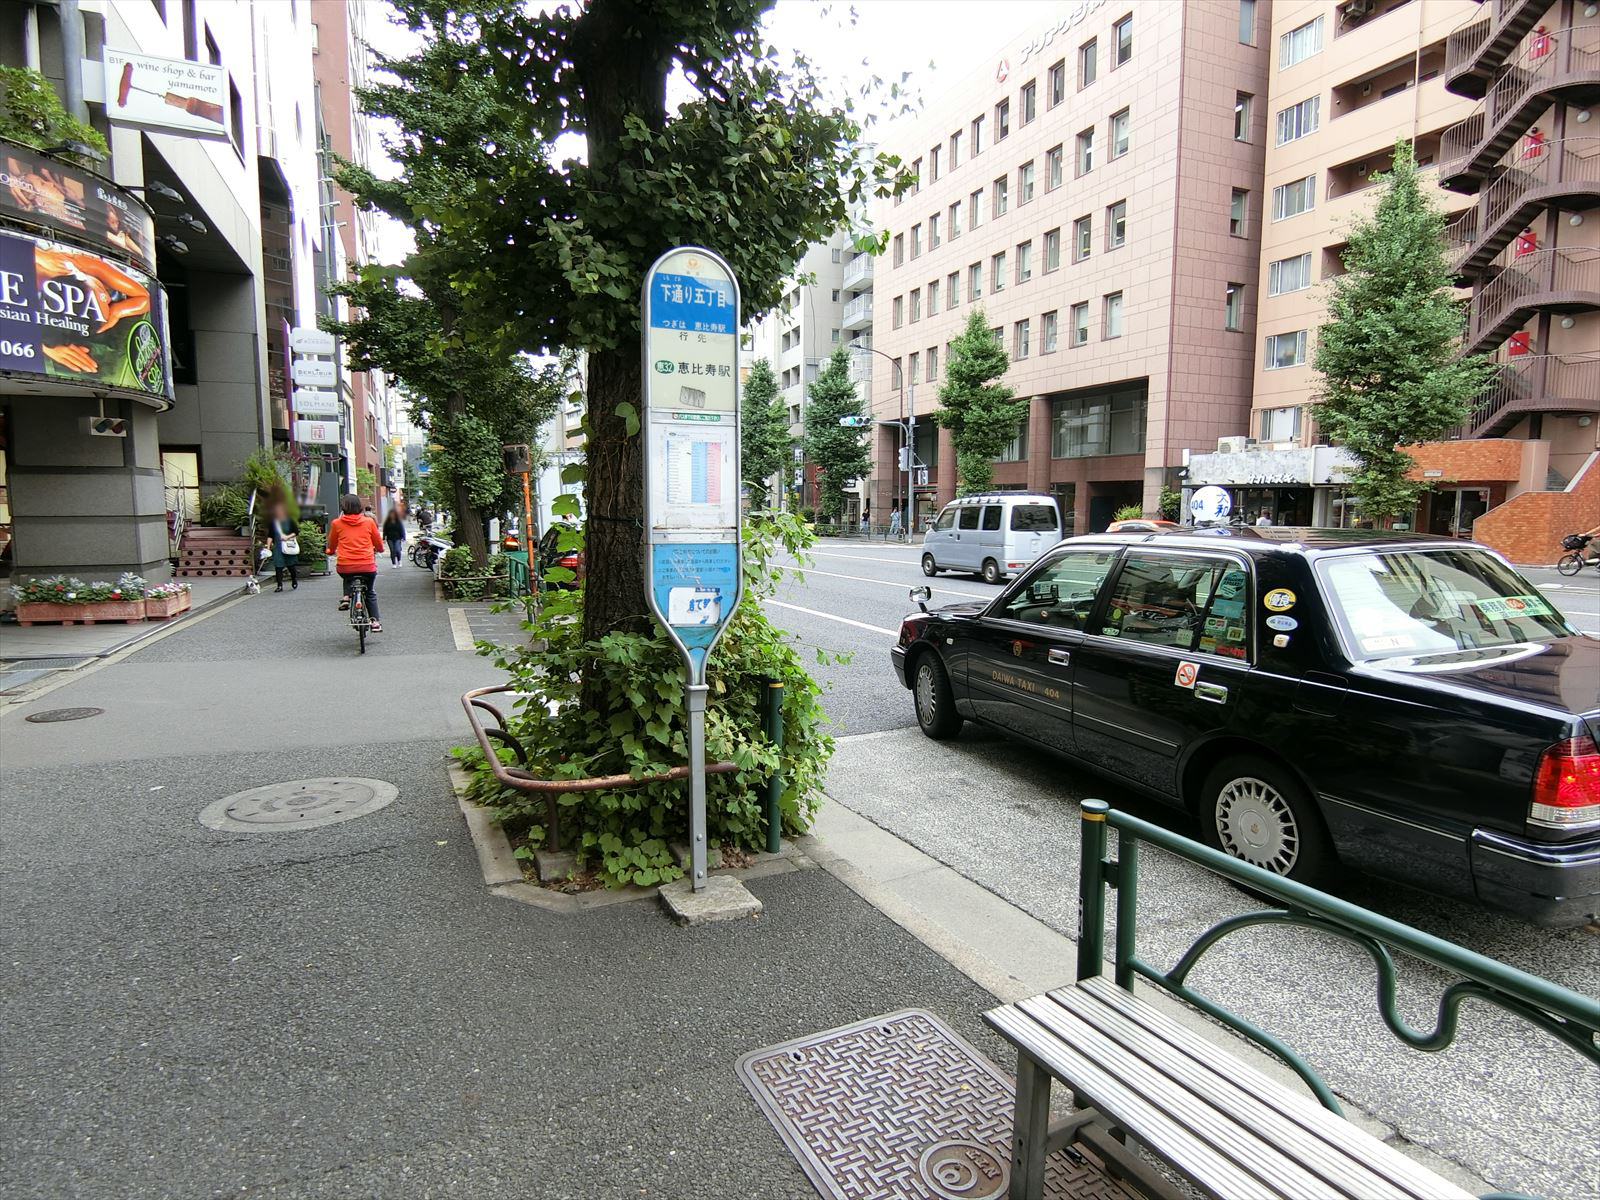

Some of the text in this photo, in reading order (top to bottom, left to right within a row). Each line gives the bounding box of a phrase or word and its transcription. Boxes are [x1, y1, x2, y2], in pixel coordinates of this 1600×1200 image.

[109, 56, 125, 64] B1F
[136, 61, 217, 81] wine shop & bar
[167, 79, 218, 95] yamamoto
[43, 280, 108, 323] SPA
[660, 283, 727, 308] 下通り五丁目
[36, 311, 91, 337] Healing
[662, 320, 727, 332] つぎは 恵比寿駅
[678, 361, 731, 377] 恵比寿駅
[1214, 492, 1229, 518] 大和
[992, 670, 1060, 699] DAIWA TAXI 404
